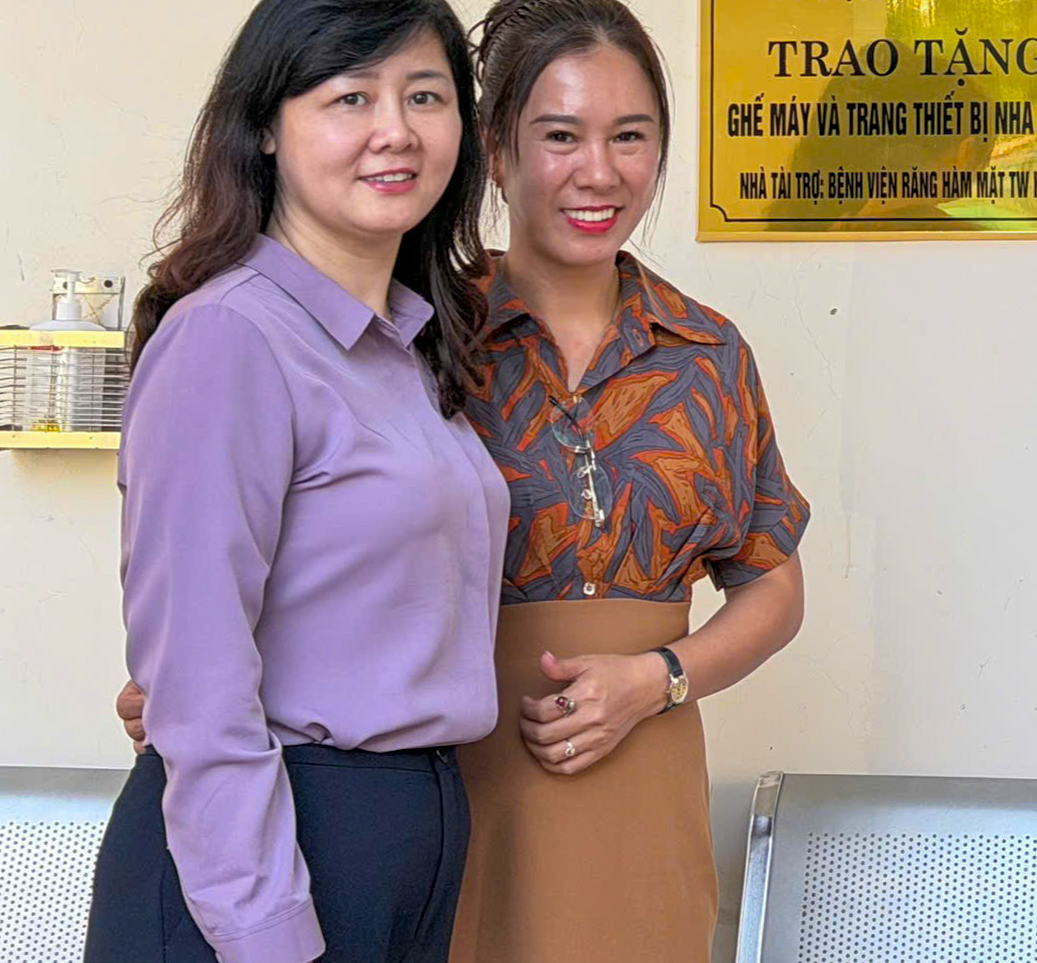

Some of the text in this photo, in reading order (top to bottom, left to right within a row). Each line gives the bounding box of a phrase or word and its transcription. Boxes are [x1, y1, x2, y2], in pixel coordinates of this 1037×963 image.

[768, 39, 899, 77] TRAO
[728, 93, 765, 137] GHẾ
[770, 96, 811, 136] MÁY
[816, 95, 840, 136] VÀ
[846, 102, 907, 136] TRANG
[913, 91, 964, 135] THIẾT
[970, 101, 988, 142] BỊ
[995, 101, 1034, 135] NHA
[740, 166, 767, 199] NHÀ
[771, 166, 791, 199] TÀI
[795, 169, 824, 205] TRỢ:
[828, 166, 863, 205] BỆNH
[867, 166, 898, 205] VIỆN
[902, 165, 938, 198] RĂNG
[942, 165, 972, 198] HÀM
[977, 165, 1005, 204] MẶT
[1008, 171, 1030, 198] TW
